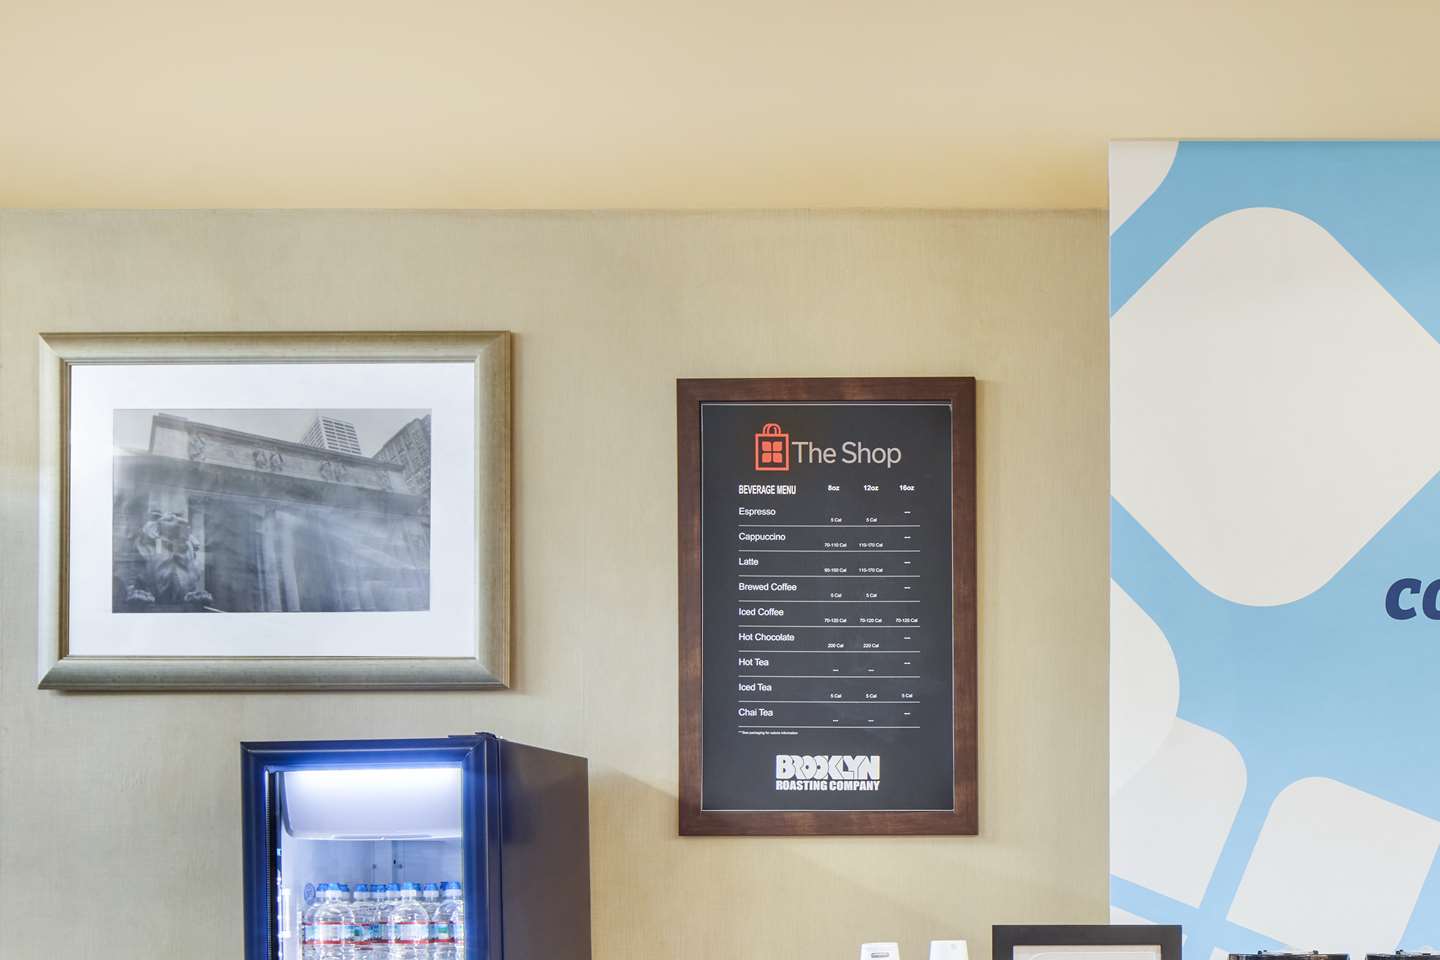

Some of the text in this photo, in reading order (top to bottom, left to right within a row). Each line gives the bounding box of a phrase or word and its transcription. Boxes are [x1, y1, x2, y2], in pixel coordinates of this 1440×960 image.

[792, 442, 902, 468] The Shop
[738, 484, 796, 495] BEVERAGE MENU
[738, 508, 776, 516] Espresso
[738, 532, 786, 542] Cappuccino
[738, 558, 758, 566] Latte
[738, 583, 797, 591] Brewed Coffee
[738, 608, 784, 616] Iced Coffee
[738, 633, 795, 642] Hot Chocolate
[738, 658, 769, 666] Hot Tea
[738, 683, 772, 692] Iced Tea
[738, 708, 773, 716] Chai Tea
[776, 755, 880, 780] BROOKLYN
[776, 780, 880, 790] ROASTING COMPANY
